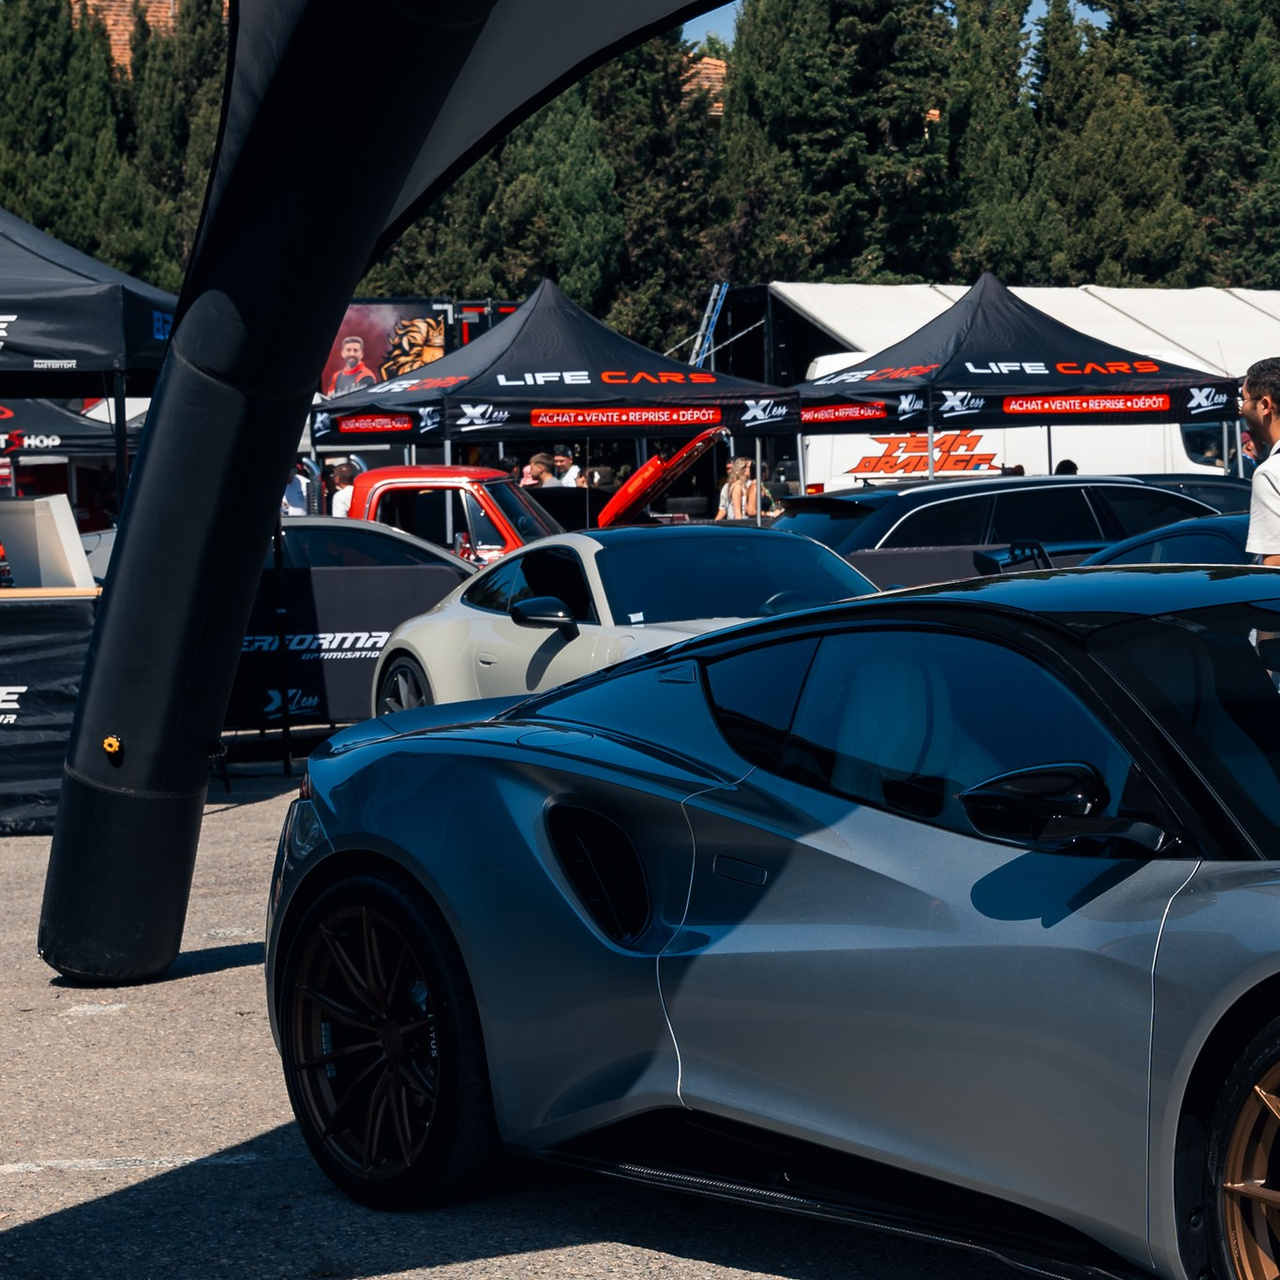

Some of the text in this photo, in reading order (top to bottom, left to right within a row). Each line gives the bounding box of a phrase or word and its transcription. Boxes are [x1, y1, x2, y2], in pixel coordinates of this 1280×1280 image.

[813, 363, 940, 386] LIFE CARS
[965, 361, 1160, 374] LIFE CARS
[497, 371, 717, 386] LIFE CARS
[1009, 396, 1164, 410] ACHAT VENTE REPRISE DÉPÔT
[537, 408, 715, 424] ACHAT VENTE REPRISE DÉPÔT
